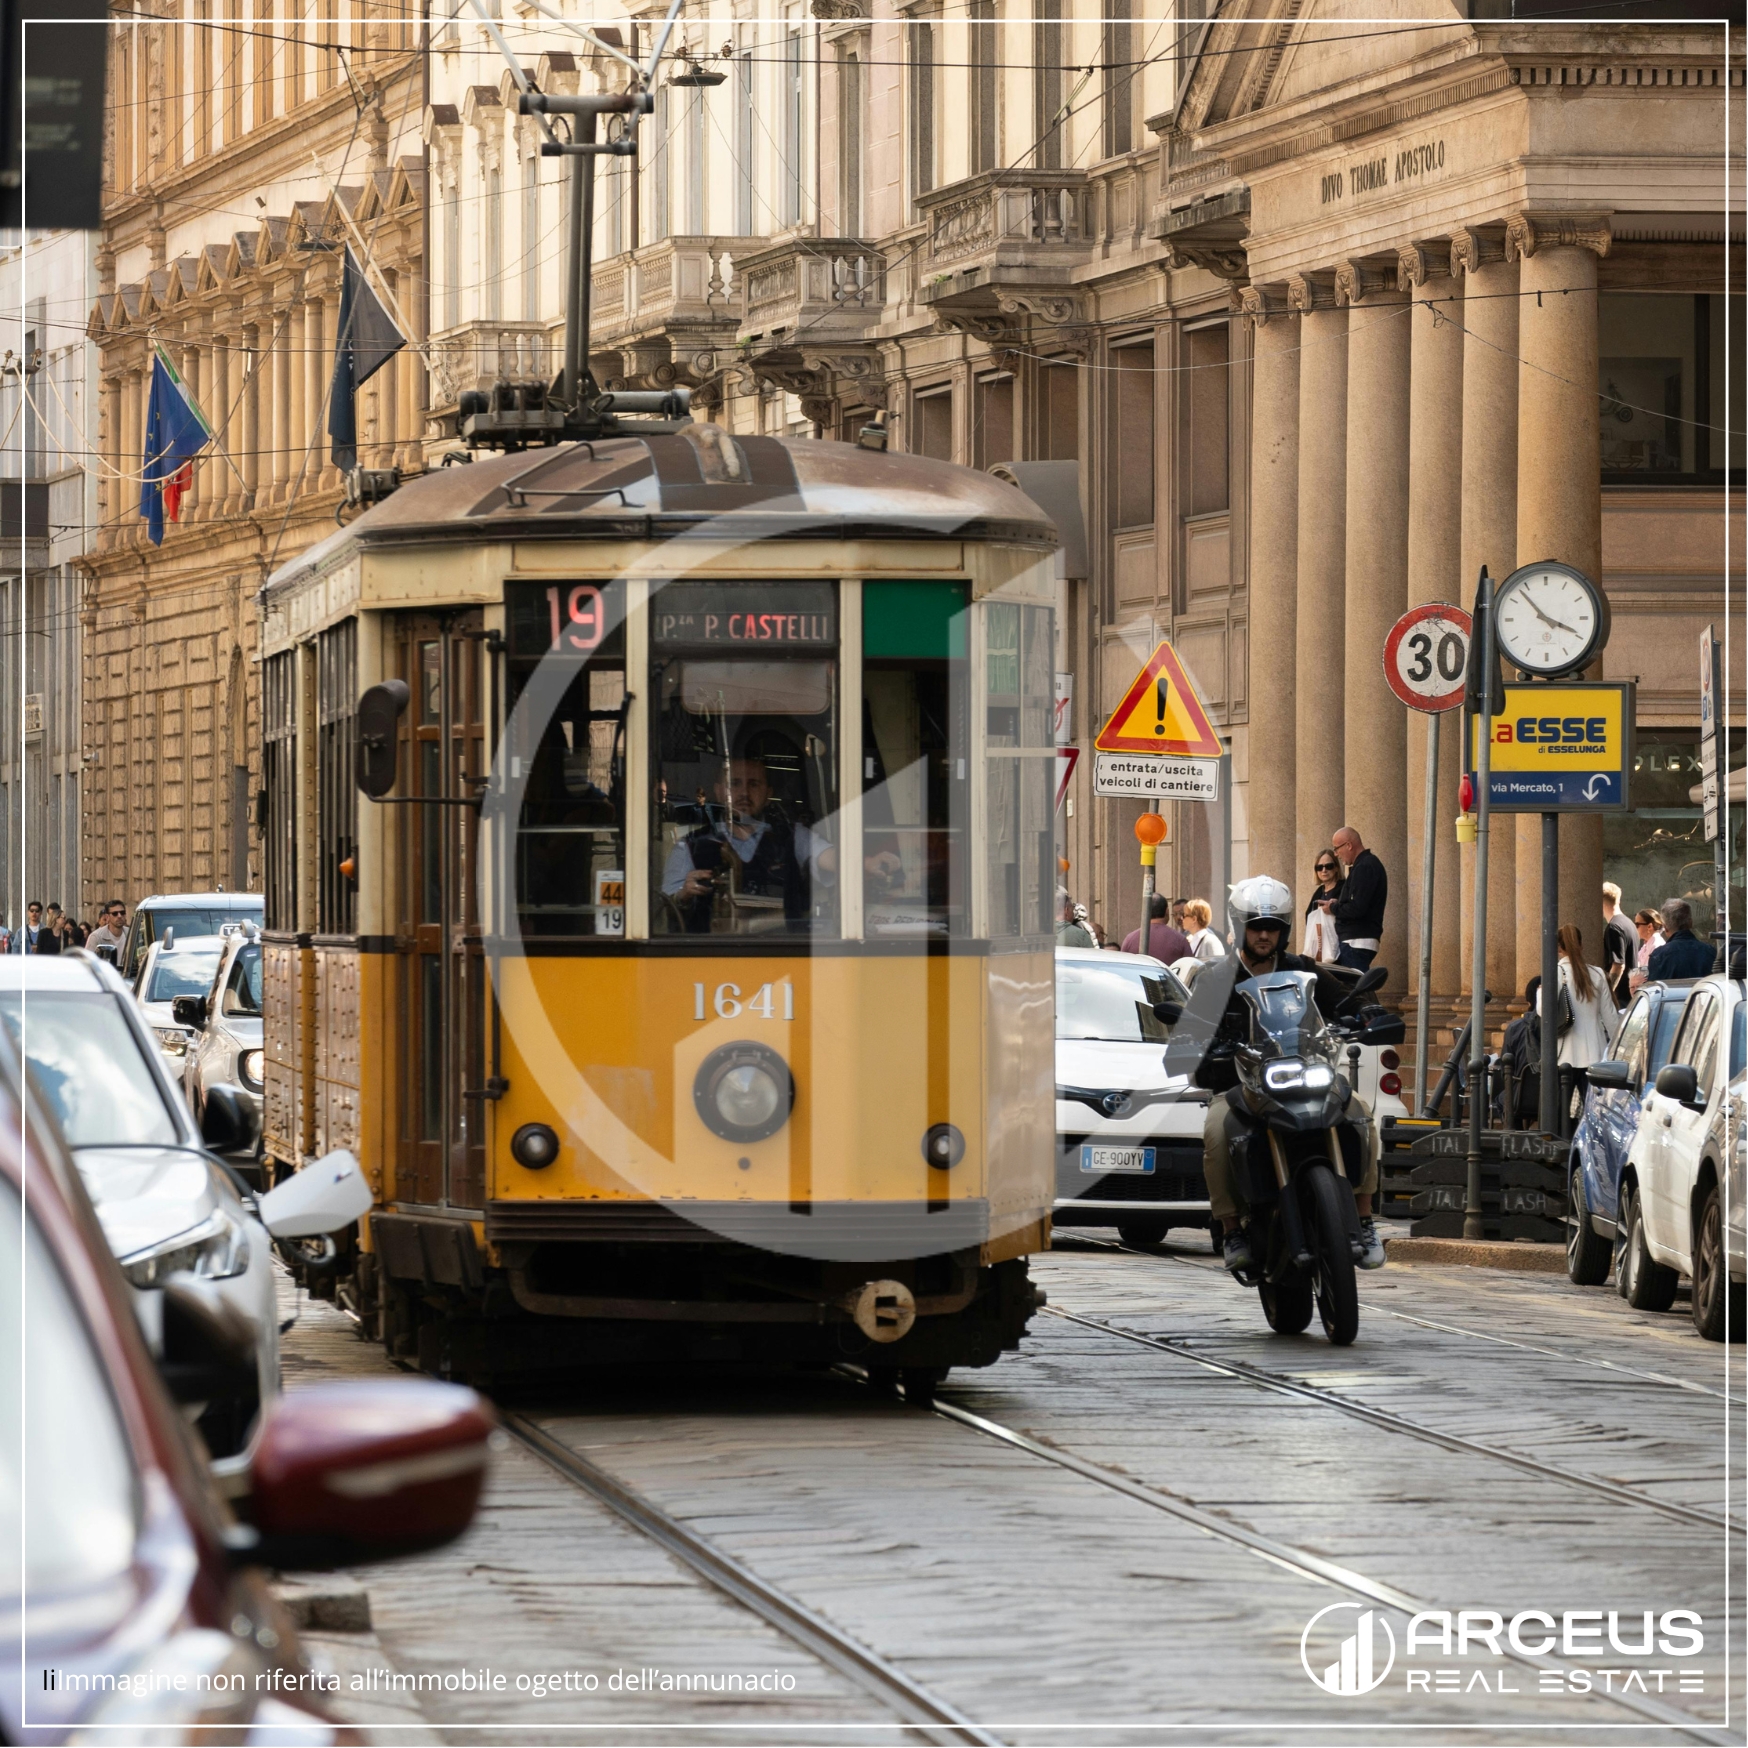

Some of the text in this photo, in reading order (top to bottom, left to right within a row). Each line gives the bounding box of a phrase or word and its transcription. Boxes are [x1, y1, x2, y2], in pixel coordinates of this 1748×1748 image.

[1321, 139, 1445, 204] DIVO THOMAE APOSTOLO
[546, 585, 604, 651] 19
[728, 614, 828, 640] CASTELLI
[1407, 632, 1465, 682] 30
[1538, 745, 1606, 753] di ESSELUNGA
[1110, 763, 1203, 776] entrata/uscita
[1099, 777, 1213, 792] veicoli di cantiere
[1491, 783, 1563, 794] via Mercato, 1
[601, 883, 622, 904] 44
[602, 908, 622, 929] 19
[693, 982, 795, 1021] 1641
